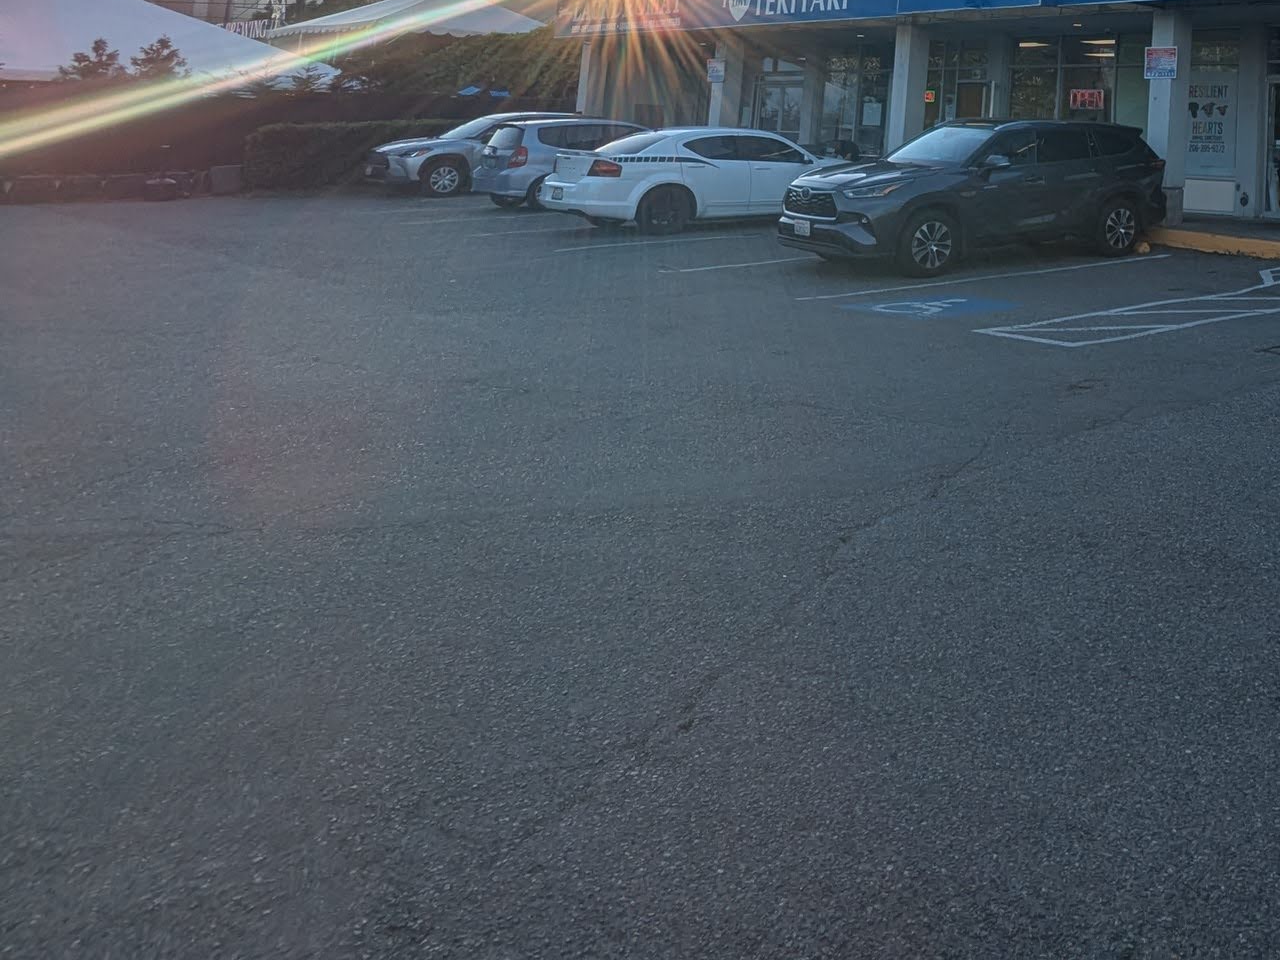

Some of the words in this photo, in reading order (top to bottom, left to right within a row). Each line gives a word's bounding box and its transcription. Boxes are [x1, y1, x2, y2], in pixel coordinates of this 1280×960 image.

[1188, 85, 1229, 98] RESILIENT
[1071, 90, 1104, 109] OPEN
[1192, 121, 1224, 135] HEARTS
